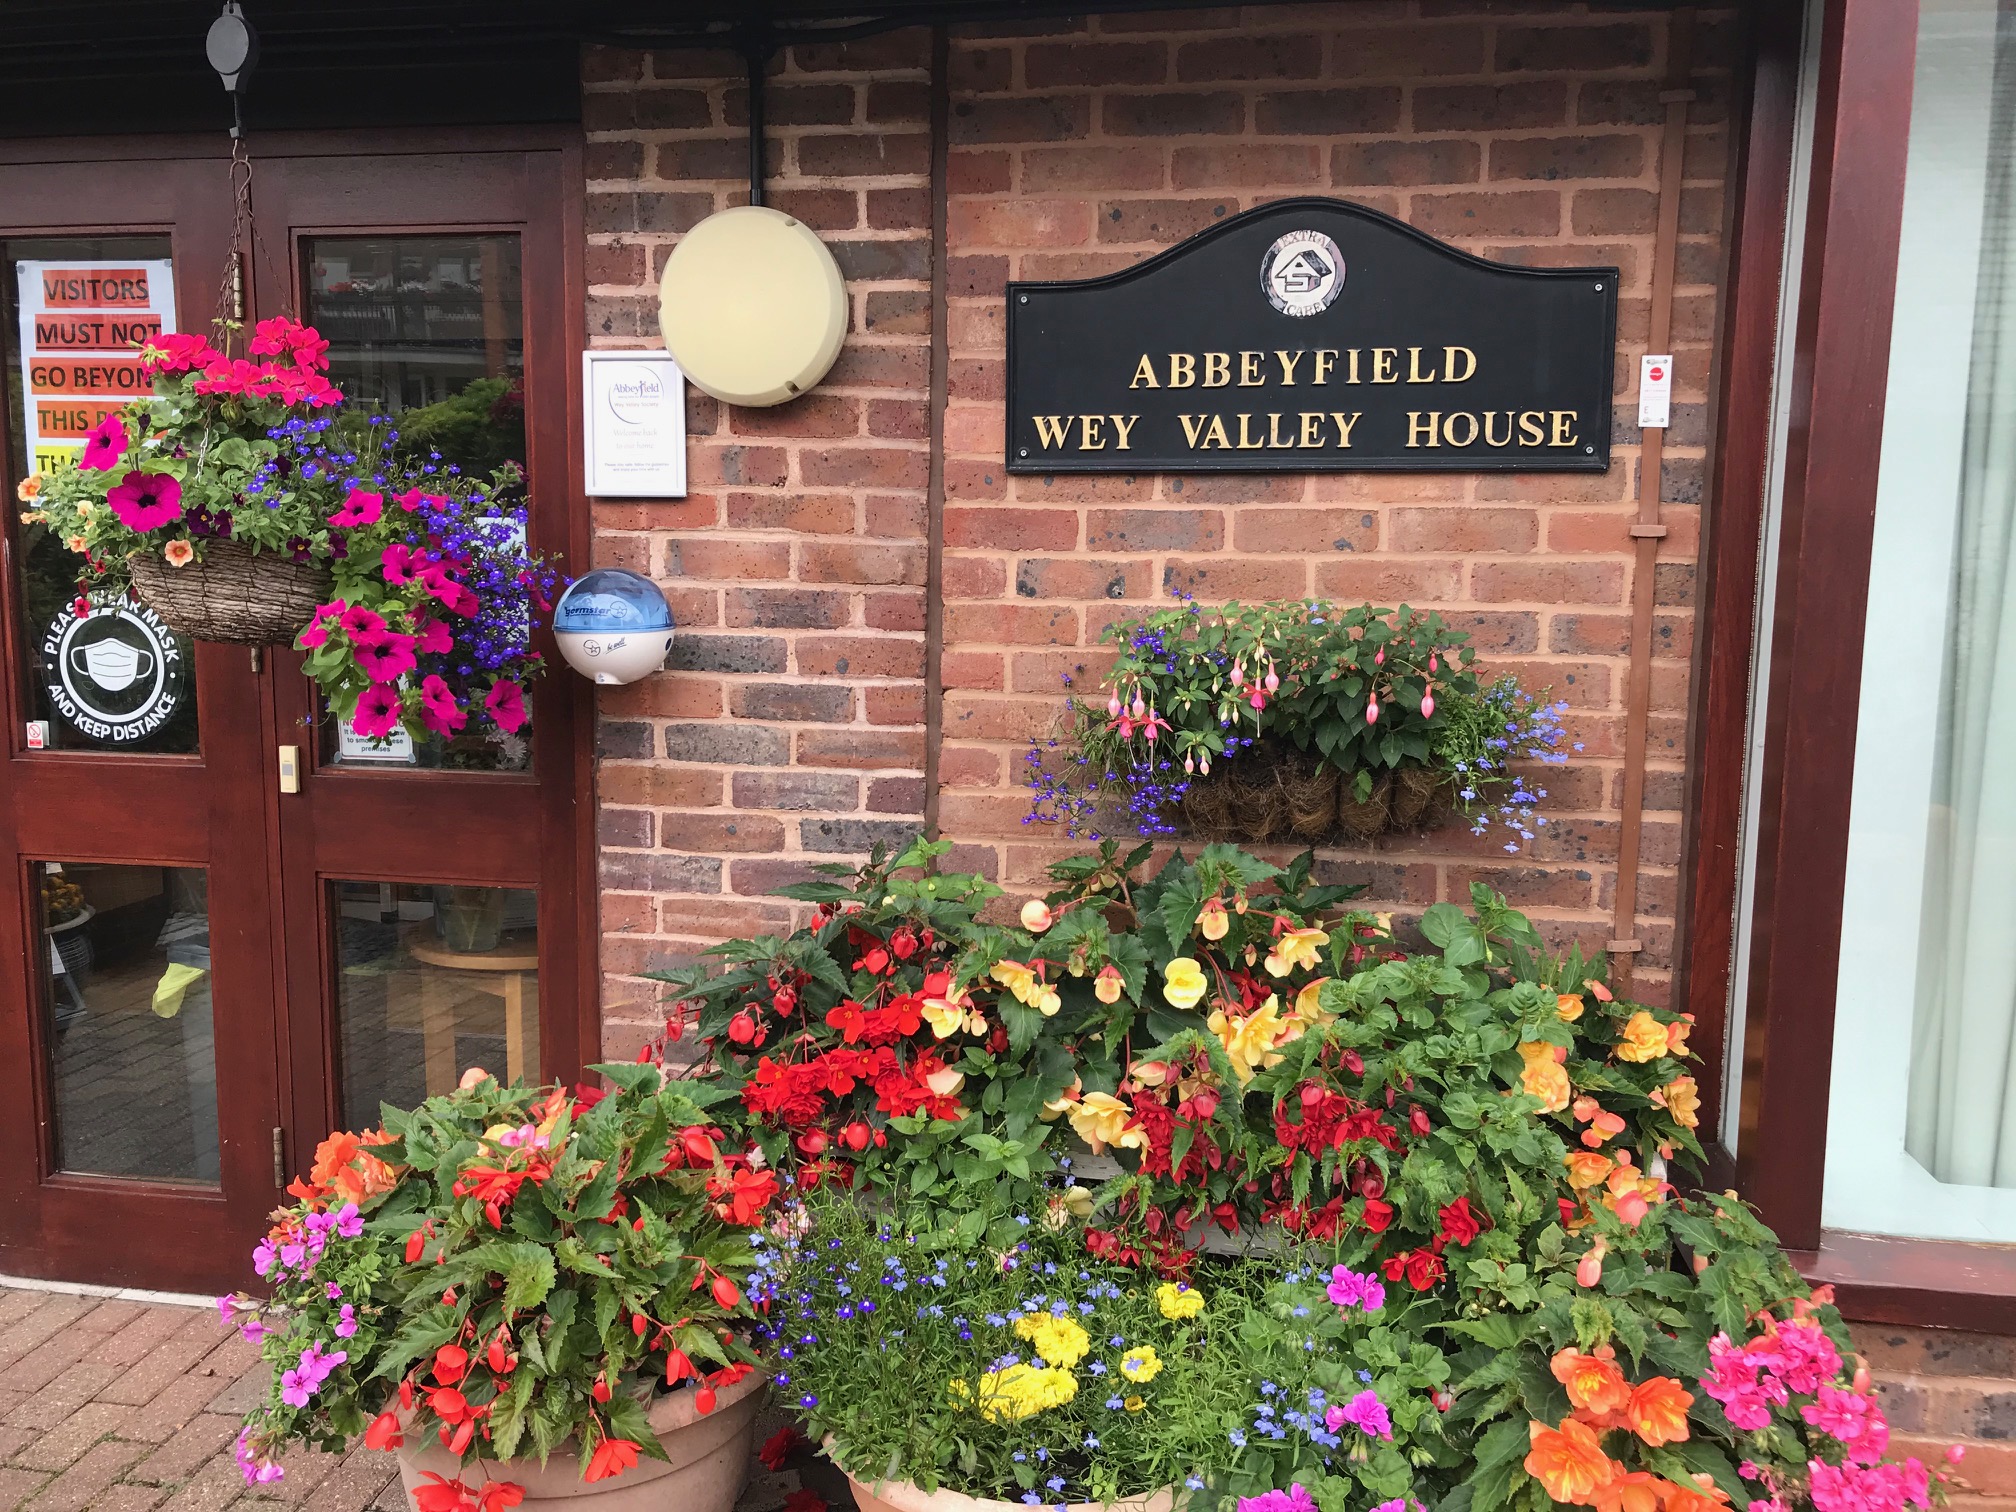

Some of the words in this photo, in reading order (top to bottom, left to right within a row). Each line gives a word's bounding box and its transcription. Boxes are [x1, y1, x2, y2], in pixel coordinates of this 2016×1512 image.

[1279, 230, 1327, 248] EXTRA
[44, 278, 148, 301] VISITORS
[1287, 302, 1322, 316] CARE
[36, 323, 104, 345] MUST
[112, 323, 161, 344] NOT
[31, 366, 66, 388] GO
[73, 367, 153, 388] BEYON
[1129, 346, 1477, 390] ABBEYFIELD
[613, 381, 659, 398] Abbeyfield
[38, 409, 89, 431] THIS
[1032, 414, 1141, 451] WEY
[1178, 412, 1362, 450] VALLEY
[1405, 410, 1579, 449] HOUSE
[142, 608, 179, 663] MASK
[49, 684, 76, 718] AND
[74, 712, 111, 739] KEEP
[113, 691, 177, 741] DISTANCE
